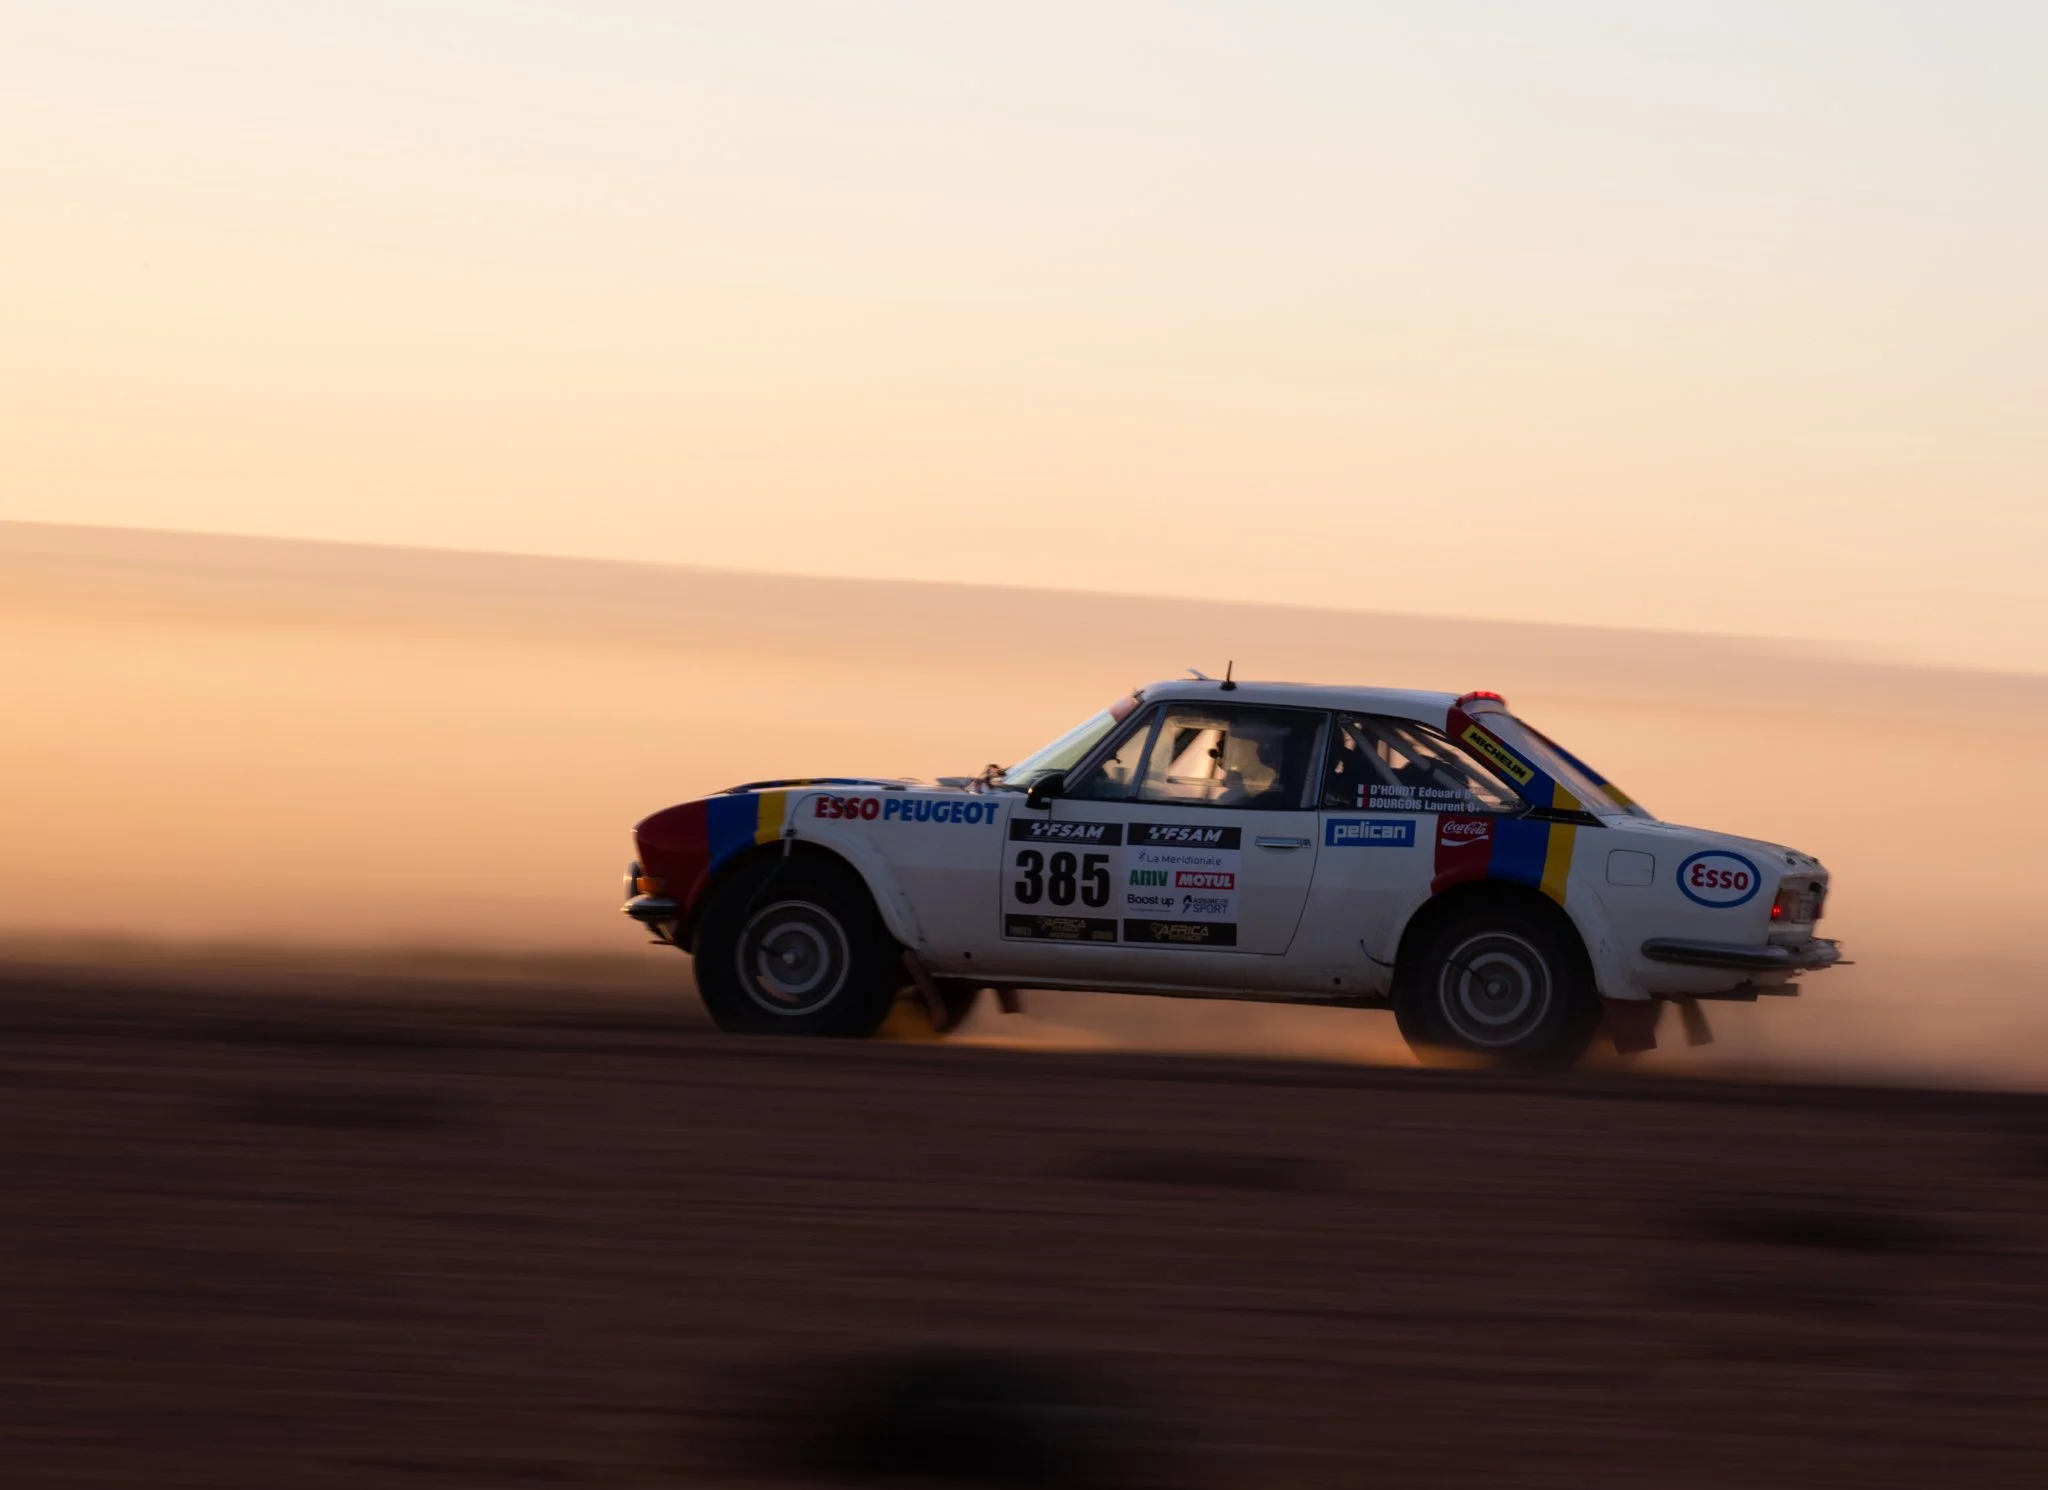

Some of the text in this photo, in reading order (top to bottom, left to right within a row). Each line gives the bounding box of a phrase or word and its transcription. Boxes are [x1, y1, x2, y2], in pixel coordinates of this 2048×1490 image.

[1468, 731, 1527, 779] MICHELIN
[1418, 786, 1461, 799] Edouard
[815, 797, 999, 825] ESSO PEUGEOT
[1369, 797, 1422, 810] BOURGOIS
[1424, 800, 1465, 812] Laurent
[1333, 820, 1407, 844] pelican
[1146, 854, 1159, 863] La
[1014, 849, 1110, 908] 385
[1178, 873, 1233, 888] MOTUL
[1127, 894, 1174, 908] Boost up
[1193, 903, 1228, 914] SPORT
[1157, 923, 1209, 936] AFRICA
